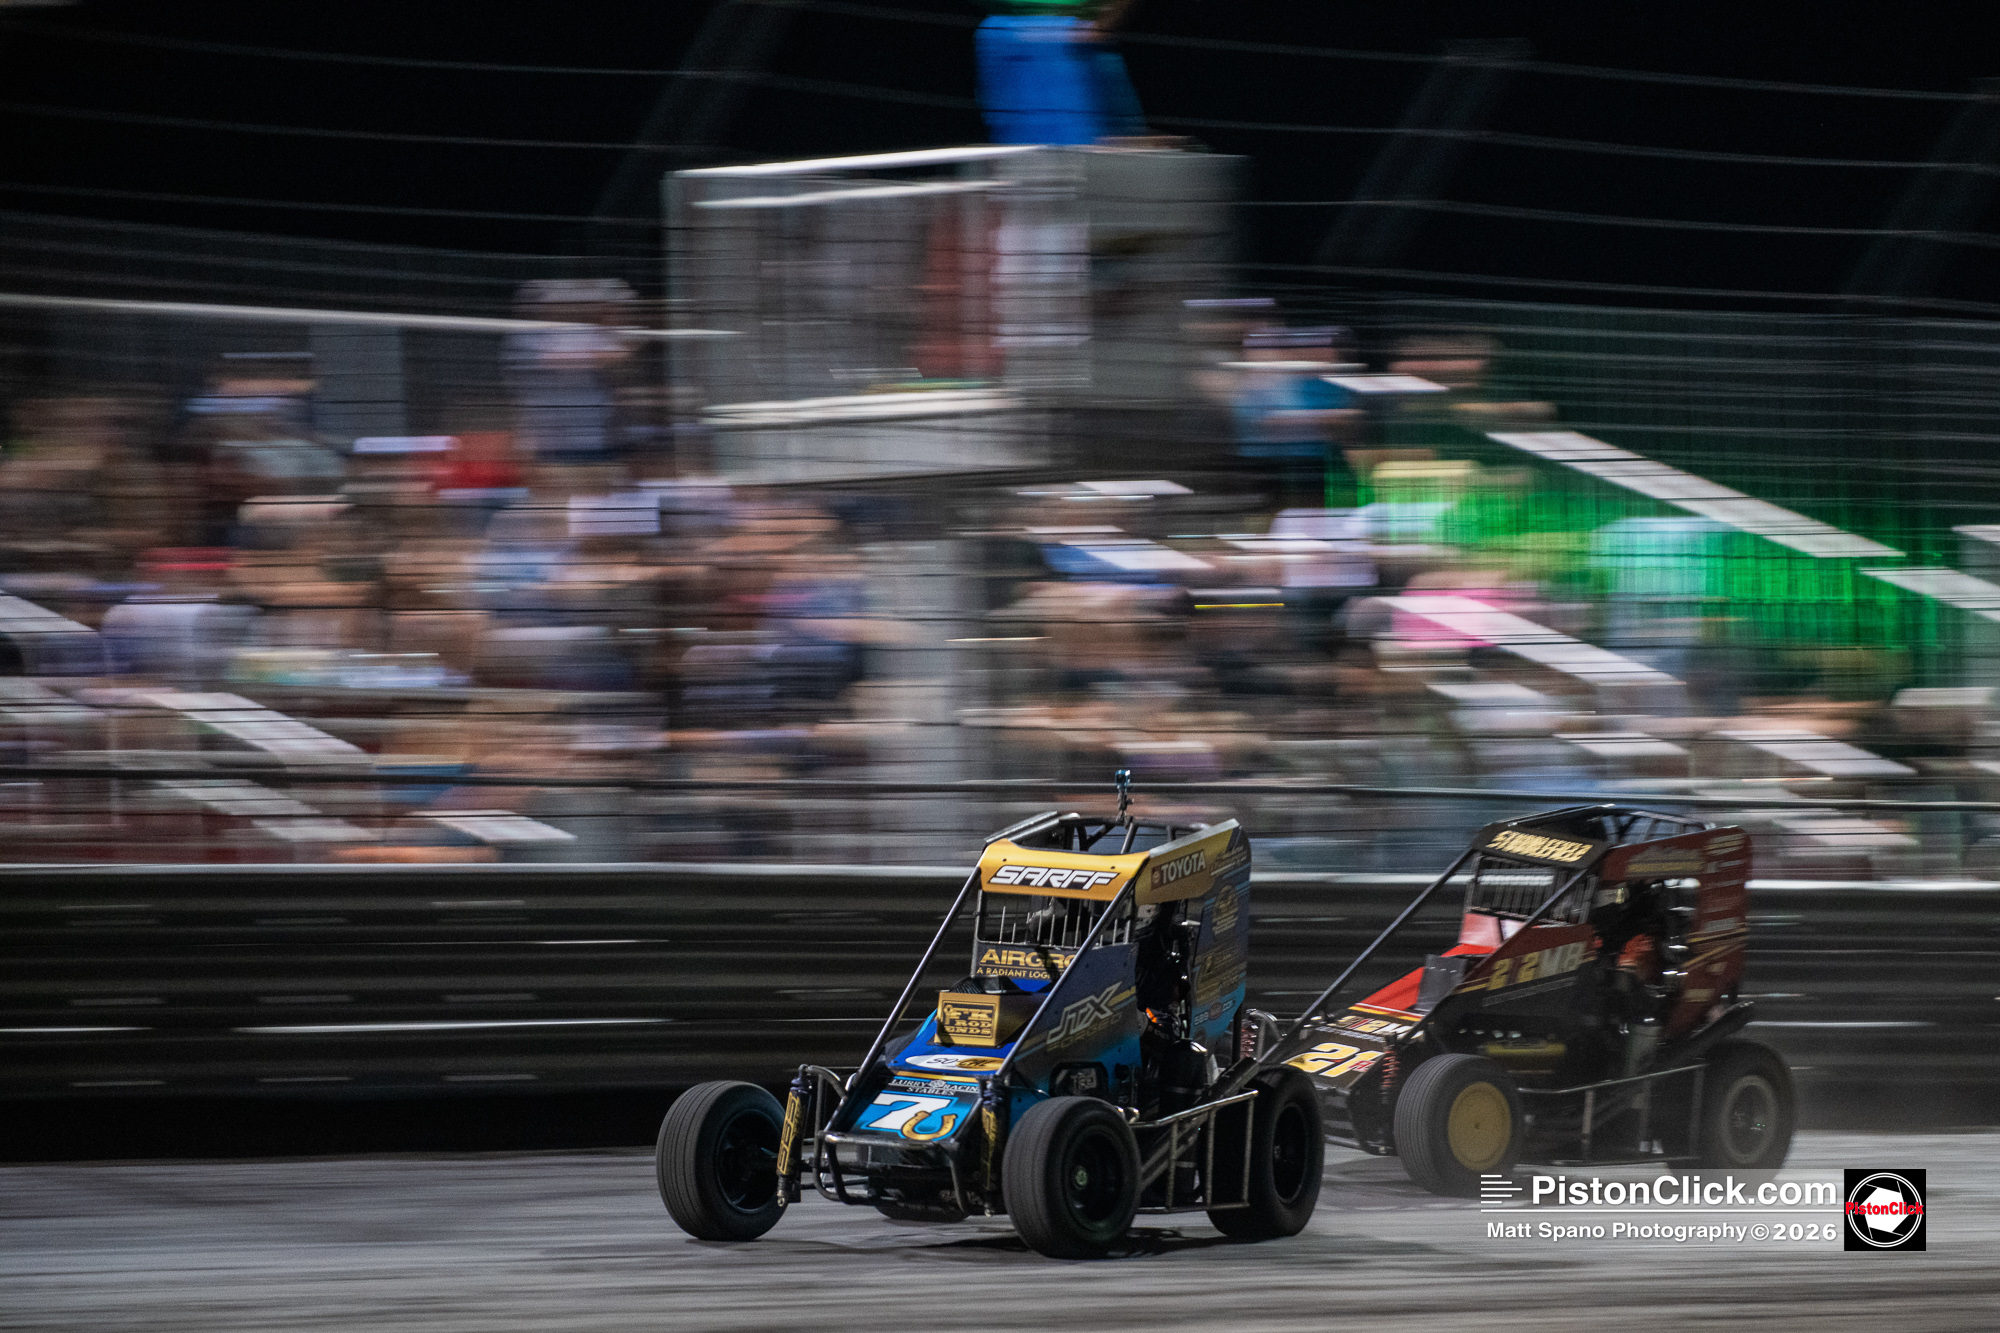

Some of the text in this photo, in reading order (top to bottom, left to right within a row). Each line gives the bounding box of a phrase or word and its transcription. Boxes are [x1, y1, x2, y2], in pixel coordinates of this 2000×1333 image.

[1161, 851, 1206, 884] TOYOTA
[990, 865, 1119, 890] SARFF
[986, 968, 1026, 978] RADIANT
[955, 1020, 992, 1028] ROD
[944, 1026, 992, 1035] ENDS
[907, 1087, 955, 1096] STABLES
[943, 1083, 980, 1092] RACIN
